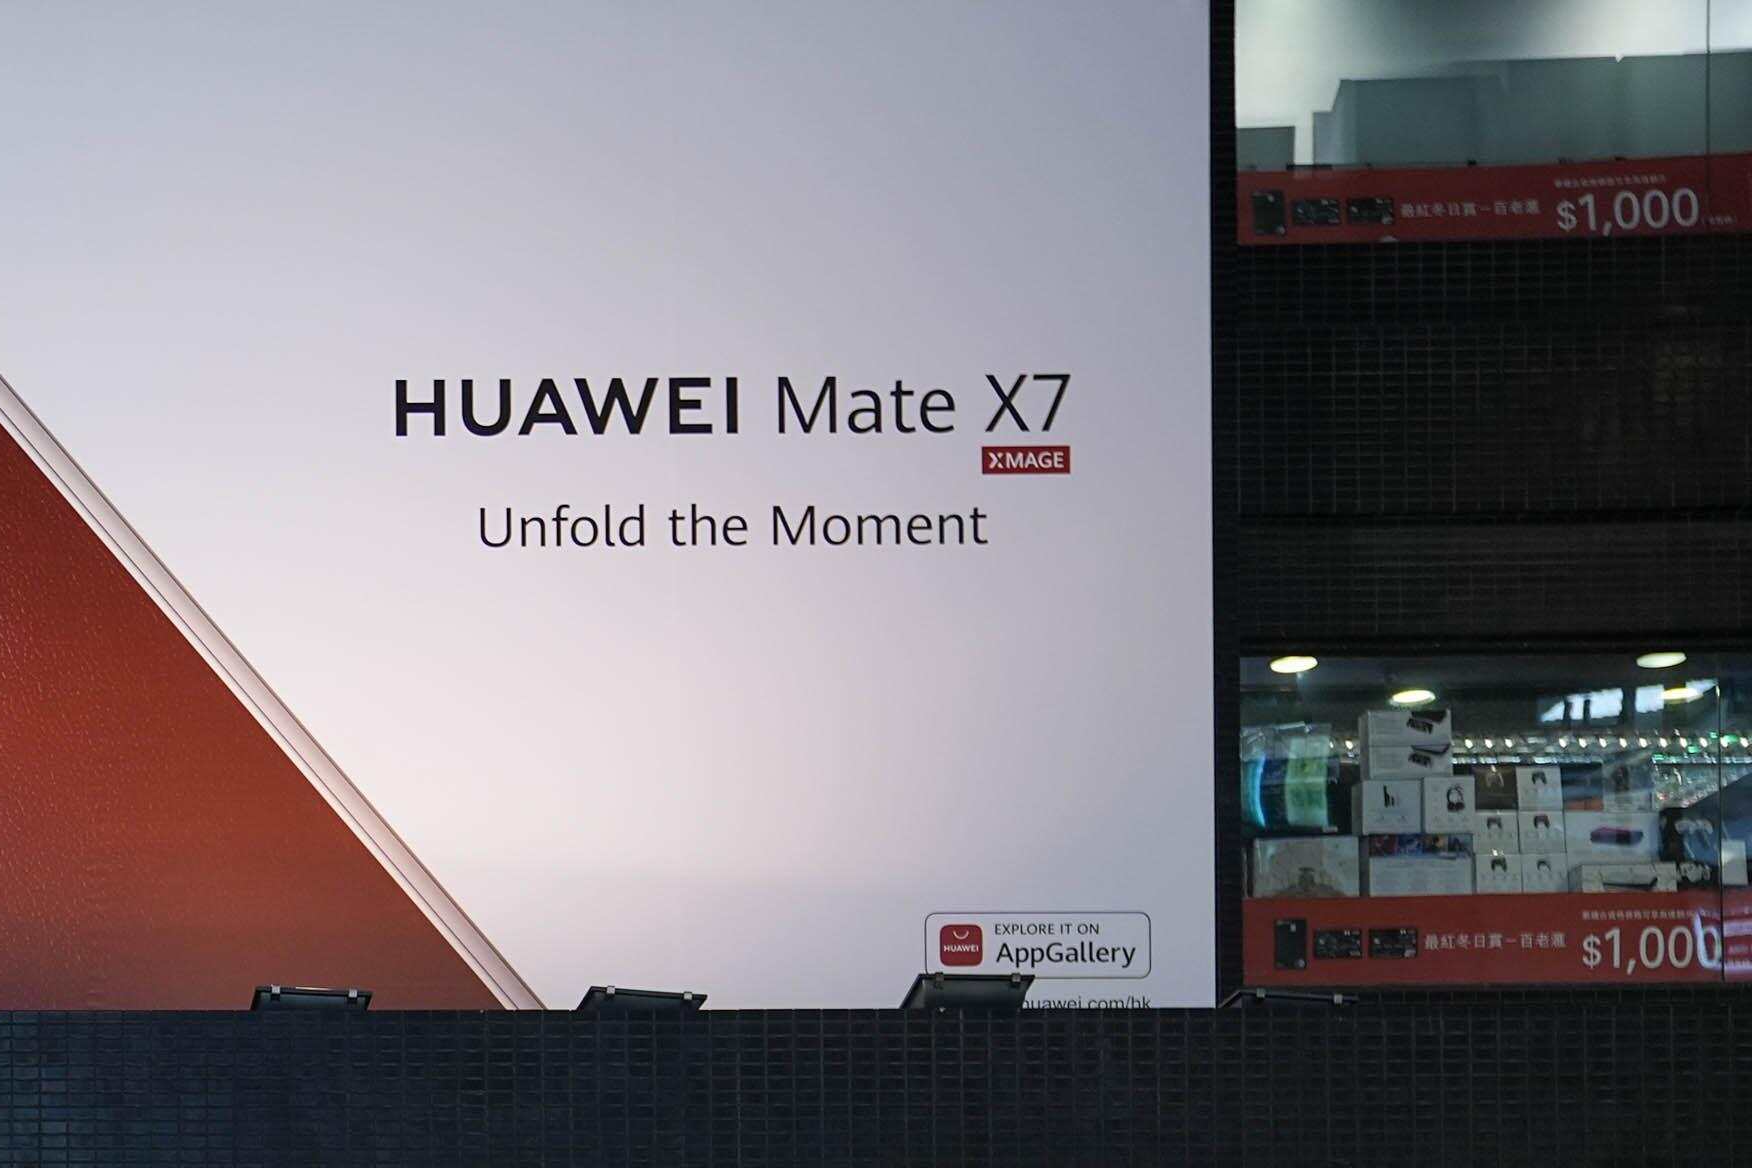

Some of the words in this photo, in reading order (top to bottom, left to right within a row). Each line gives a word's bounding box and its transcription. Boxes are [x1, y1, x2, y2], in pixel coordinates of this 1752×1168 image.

[1556, 187, 1700, 236] $1,000
[395, 376, 740, 437] HUAWEI
[776, 375, 957, 435] Mate
[983, 373, 1073, 433] X7
[987, 450, 1065, 471] XMAGE
[477, 503, 647, 548] Unfold
[667, 503, 749, 547] the
[771, 504, 990, 547] Moment
[993, 923, 1057, 936] EXPLORE
[1060, 923, 1073, 935] IT
[1077, 923, 1099, 935] ON
[943, 945, 979, 953] HUAWEI
[995, 941, 1136, 968] AppGallery
